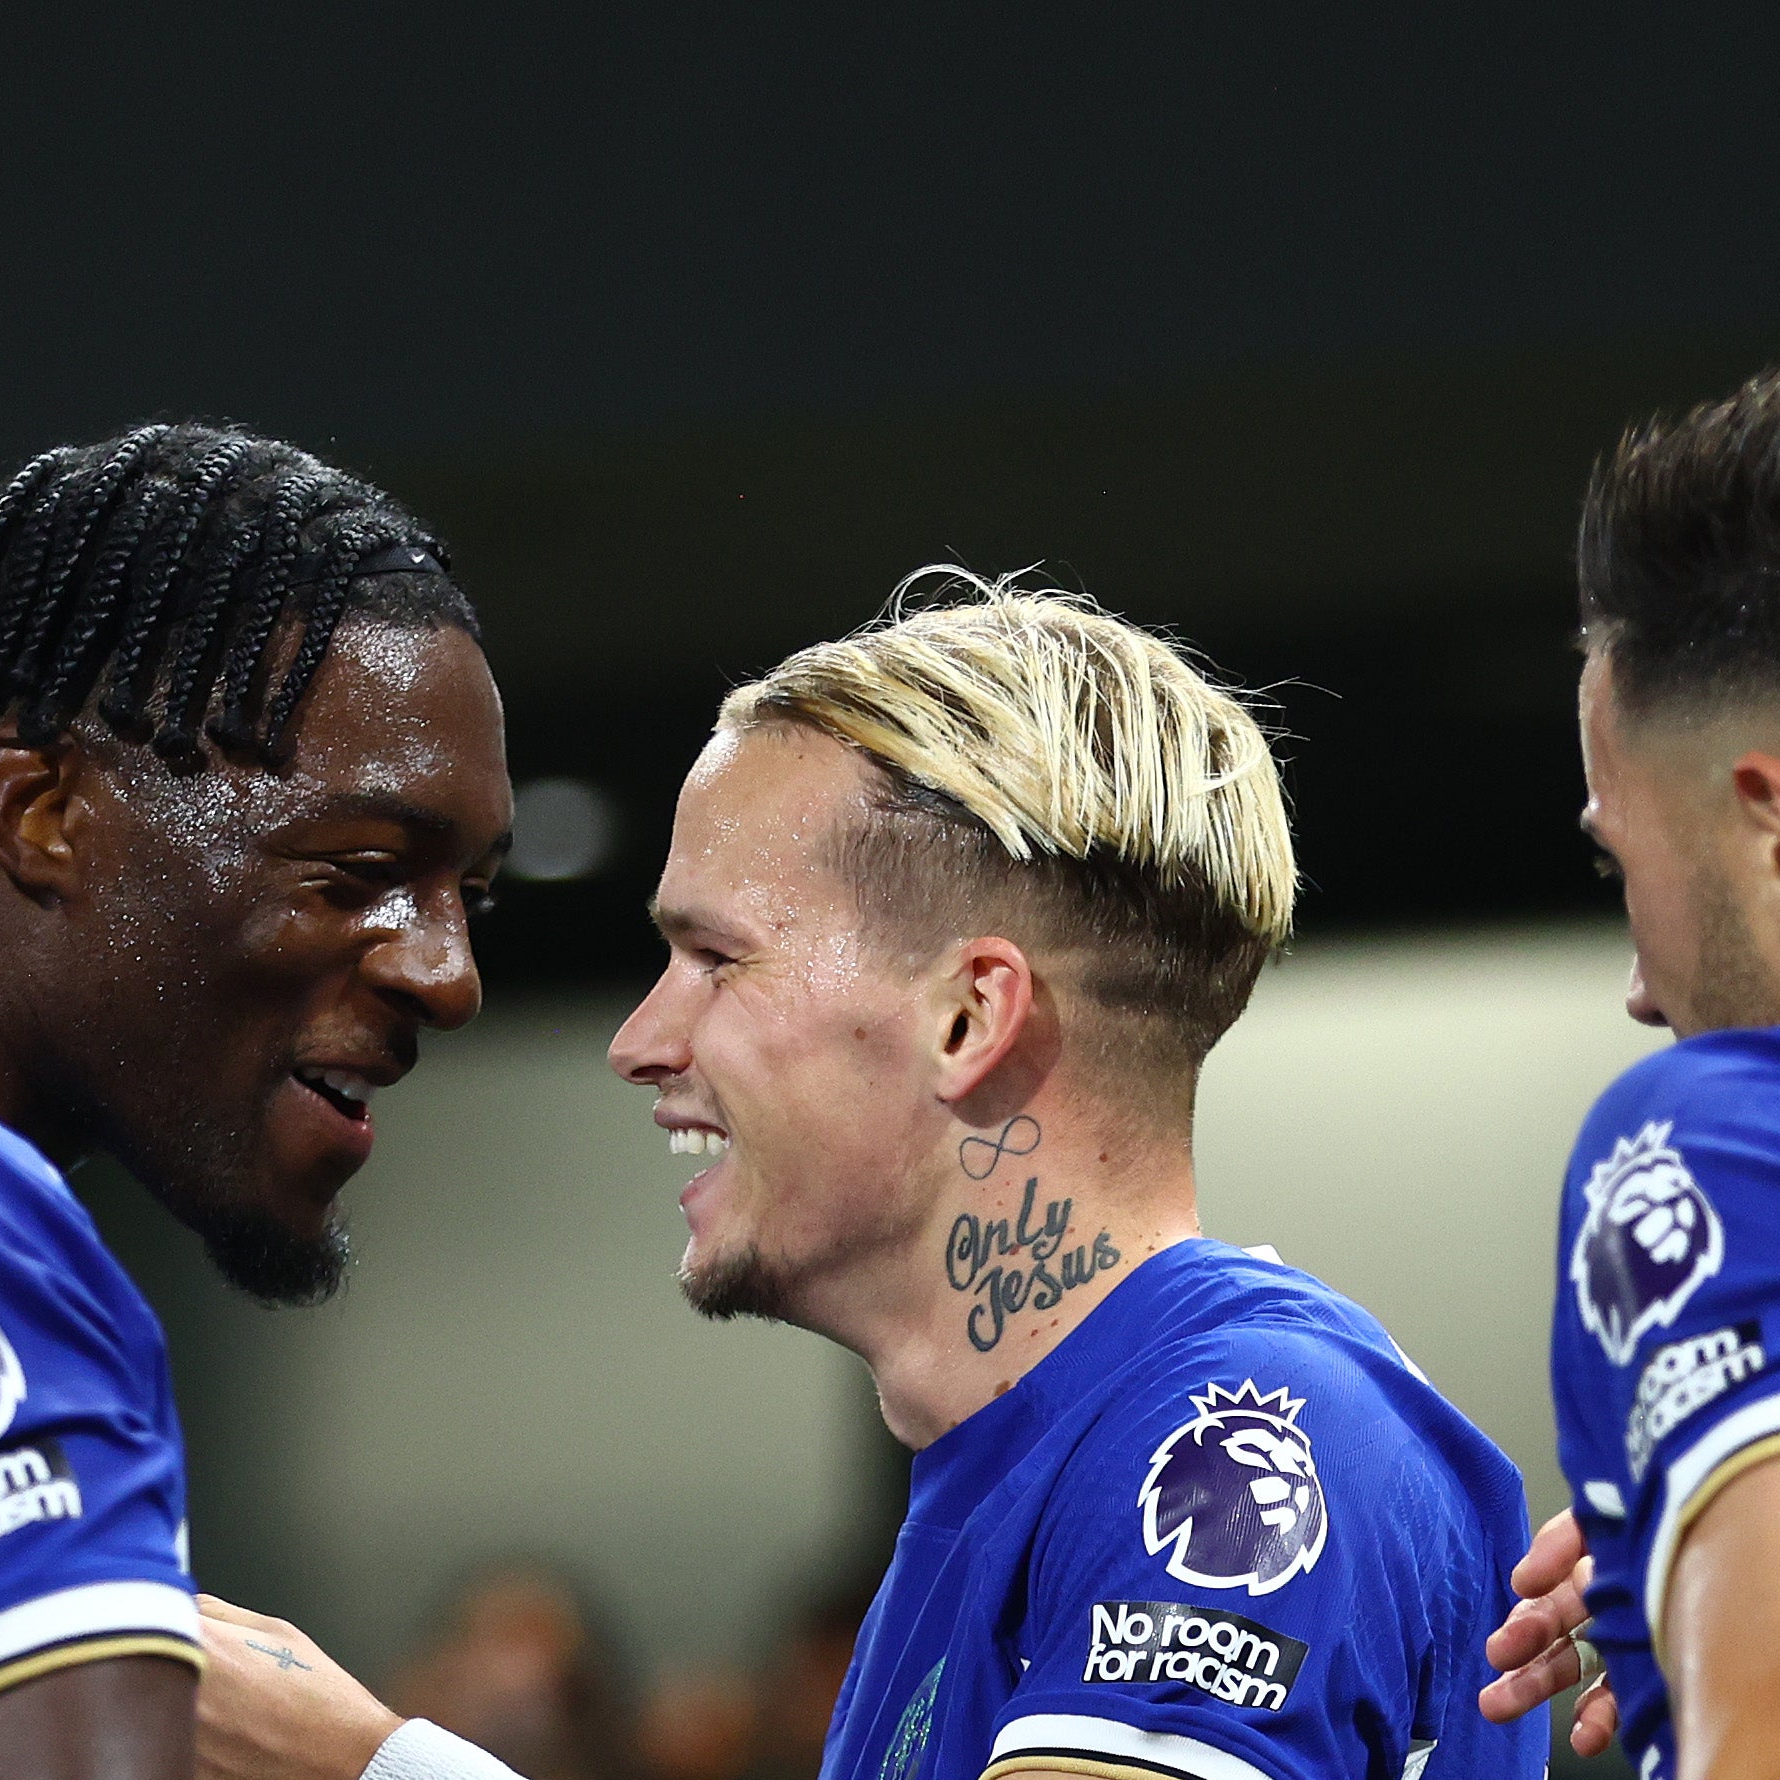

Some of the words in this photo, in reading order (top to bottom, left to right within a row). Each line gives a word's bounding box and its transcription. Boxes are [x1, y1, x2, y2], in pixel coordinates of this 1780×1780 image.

[946, 1176, 1072, 1291] Only
[968, 1231, 1121, 1352] Jesus
[1083, 1642, 1147, 1681] for
[1149, 1650, 1287, 1710] racism
[1092, 1604, 1154, 1646] No
[1160, 1614, 1280, 1676] room
